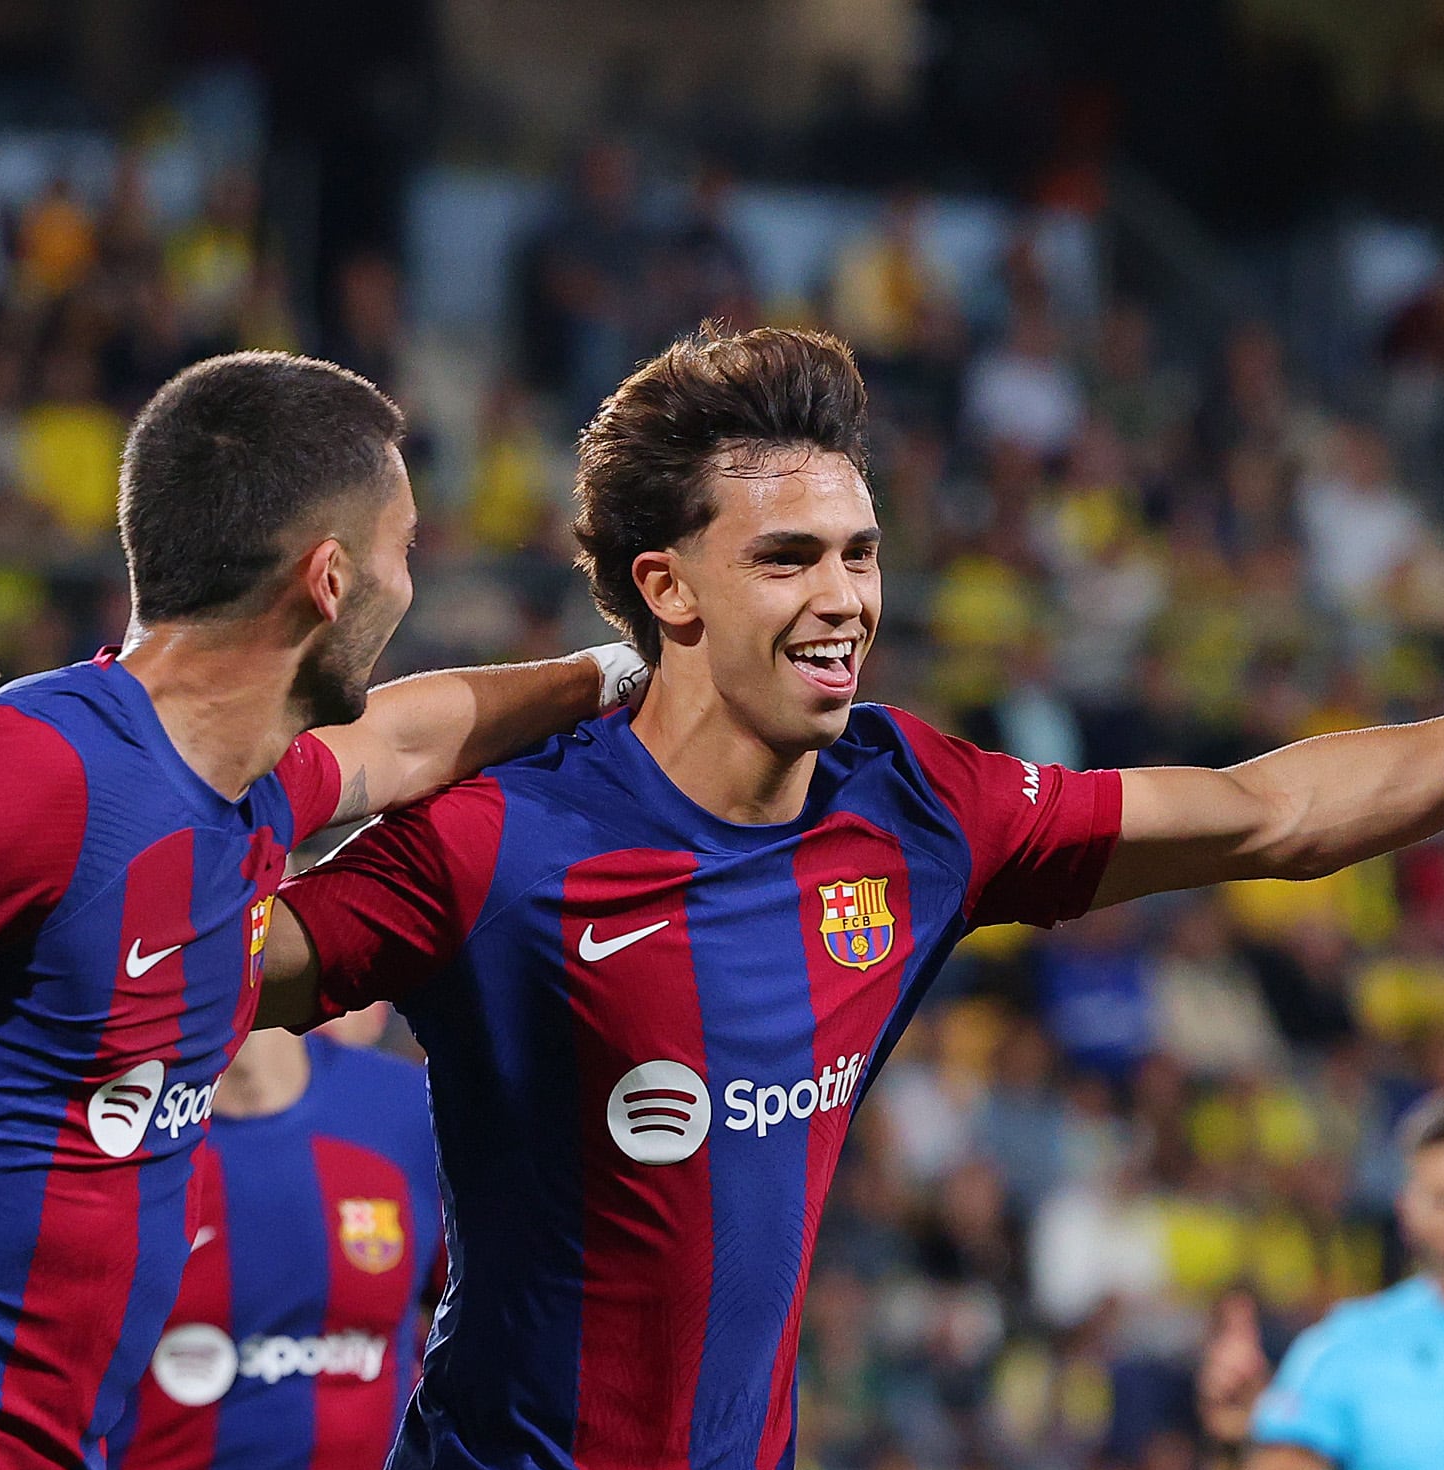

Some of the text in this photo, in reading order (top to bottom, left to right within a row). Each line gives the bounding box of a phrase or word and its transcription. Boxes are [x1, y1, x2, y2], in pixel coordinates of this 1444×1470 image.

[842, 916, 871, 929] FCB
[724, 1052, 867, 1138] Spotify
[238, 1331, 388, 1384] Spotify
